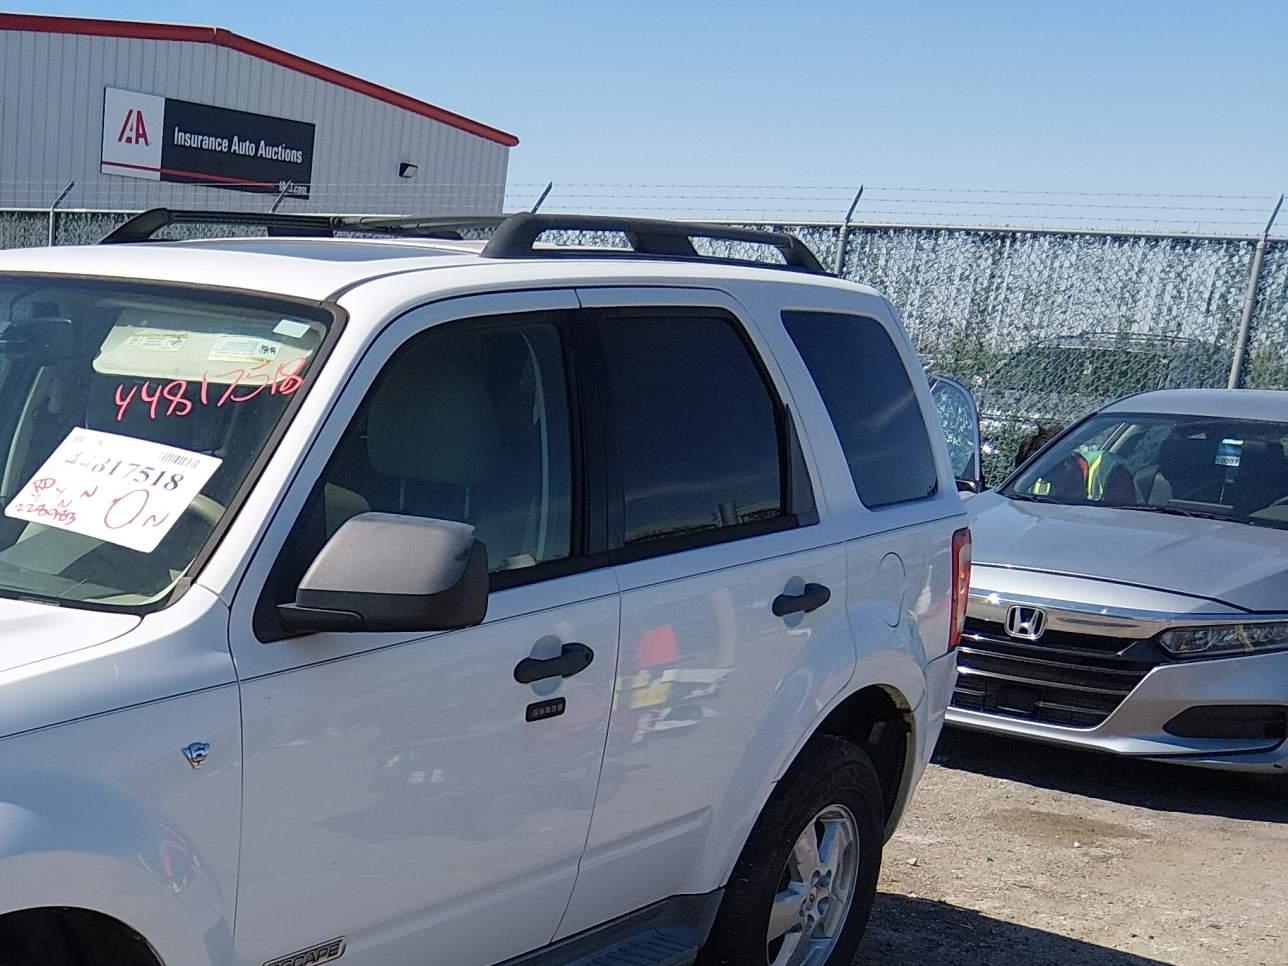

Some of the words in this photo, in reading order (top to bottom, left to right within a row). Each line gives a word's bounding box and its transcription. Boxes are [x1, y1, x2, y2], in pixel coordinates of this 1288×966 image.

[174, 126, 228, 153] Insurance
[231, 135, 256, 157] Auto
[258, 140, 303, 164] Auctions
[115, 357, 306, 421] 44817518
[65, 452, 184, 491] 817518
